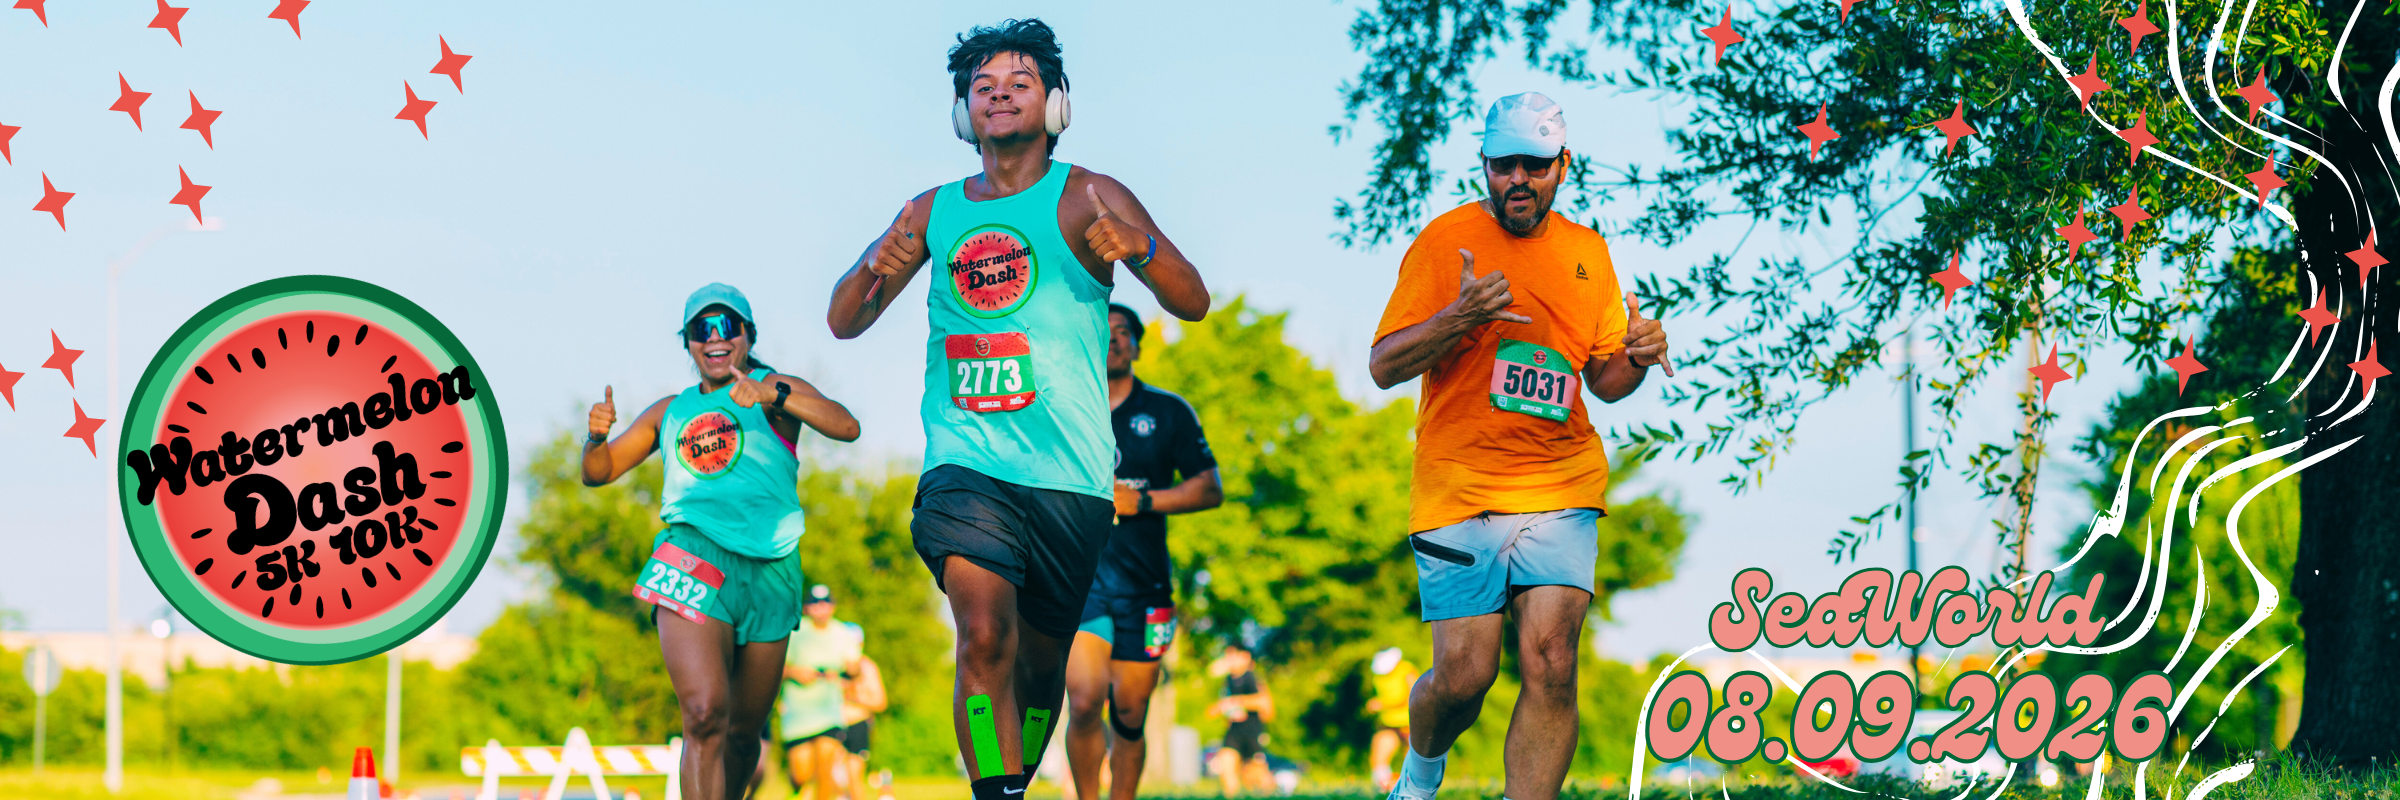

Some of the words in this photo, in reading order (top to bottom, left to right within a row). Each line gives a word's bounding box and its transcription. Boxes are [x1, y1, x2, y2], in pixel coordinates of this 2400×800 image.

[949, 246, 1032, 277] Watermelon
[968, 265, 1018, 291] Dash
[957, 359, 1022, 394] 2773
[1503, 364, 1567, 404] 5031
[677, 423, 740, 449] Watermelon
[691, 437, 727, 458] Dash
[645, 562, 708, 609] 2332
[973, 706, 986, 716] KT
[1030, 714, 1044, 723] KT
